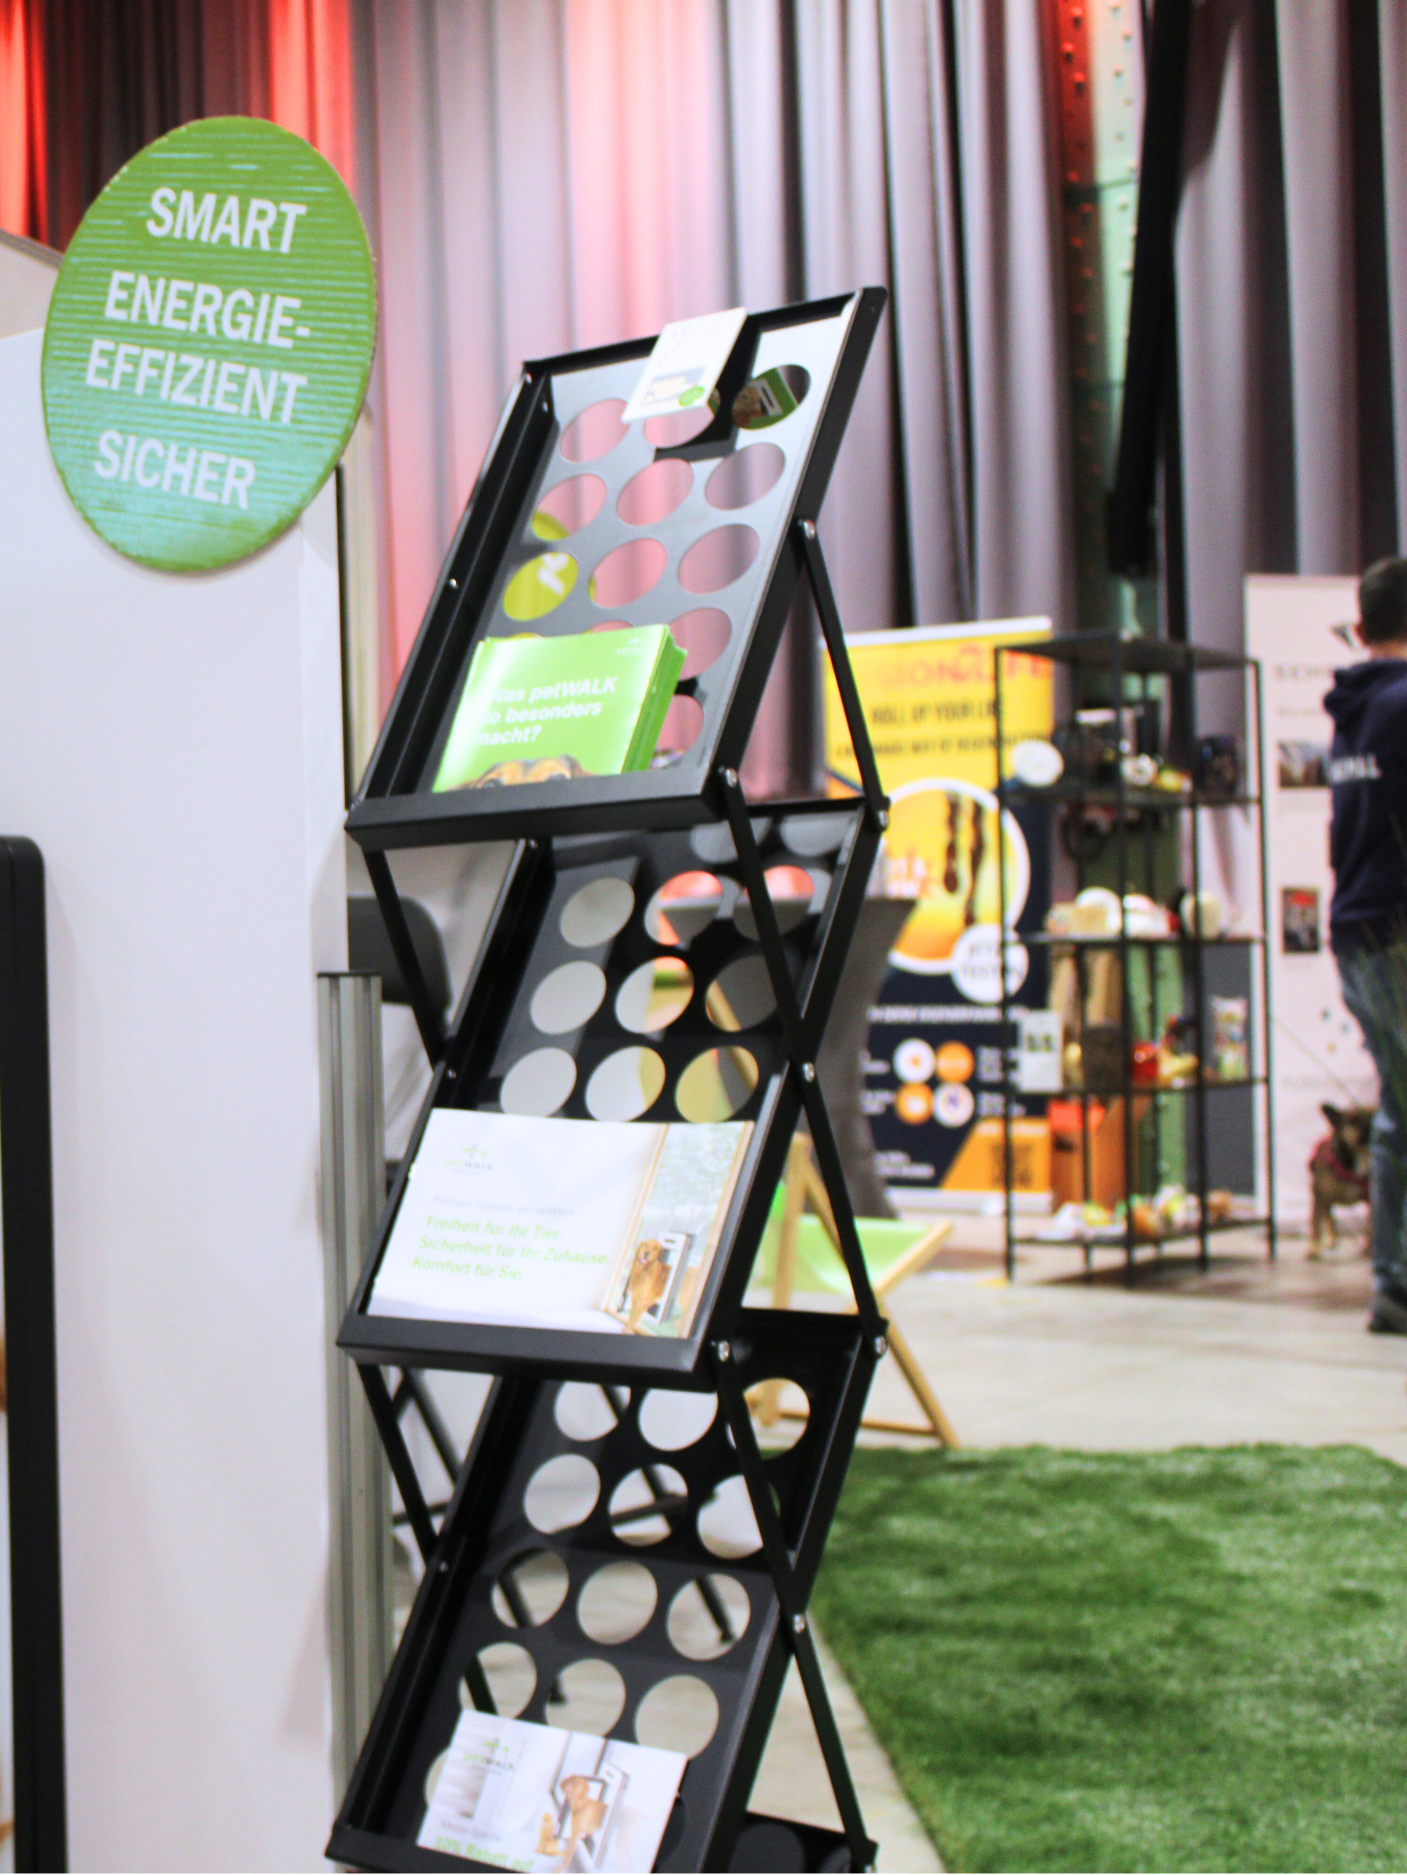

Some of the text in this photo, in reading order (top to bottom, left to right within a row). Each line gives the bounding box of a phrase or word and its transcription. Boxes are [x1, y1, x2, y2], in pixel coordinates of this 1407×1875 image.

[146, 186, 308, 254] SMART
[104, 269, 311, 349] ENERGIE-
[86, 338, 308, 425] EFFIZIENT
[94, 429, 255, 510] SICHER
[491, 676, 619, 704] Was petWALK
[505, 701, 603, 723] besonders
[473, 725, 542, 746] macht?
[425, 1214, 563, 1242] Freiheit für Ihr Tier.
[418, 1235, 611, 1266] Sicherheit für Ihr Zuhause.
[411, 1255, 524, 1281] Komfort für Sie.
